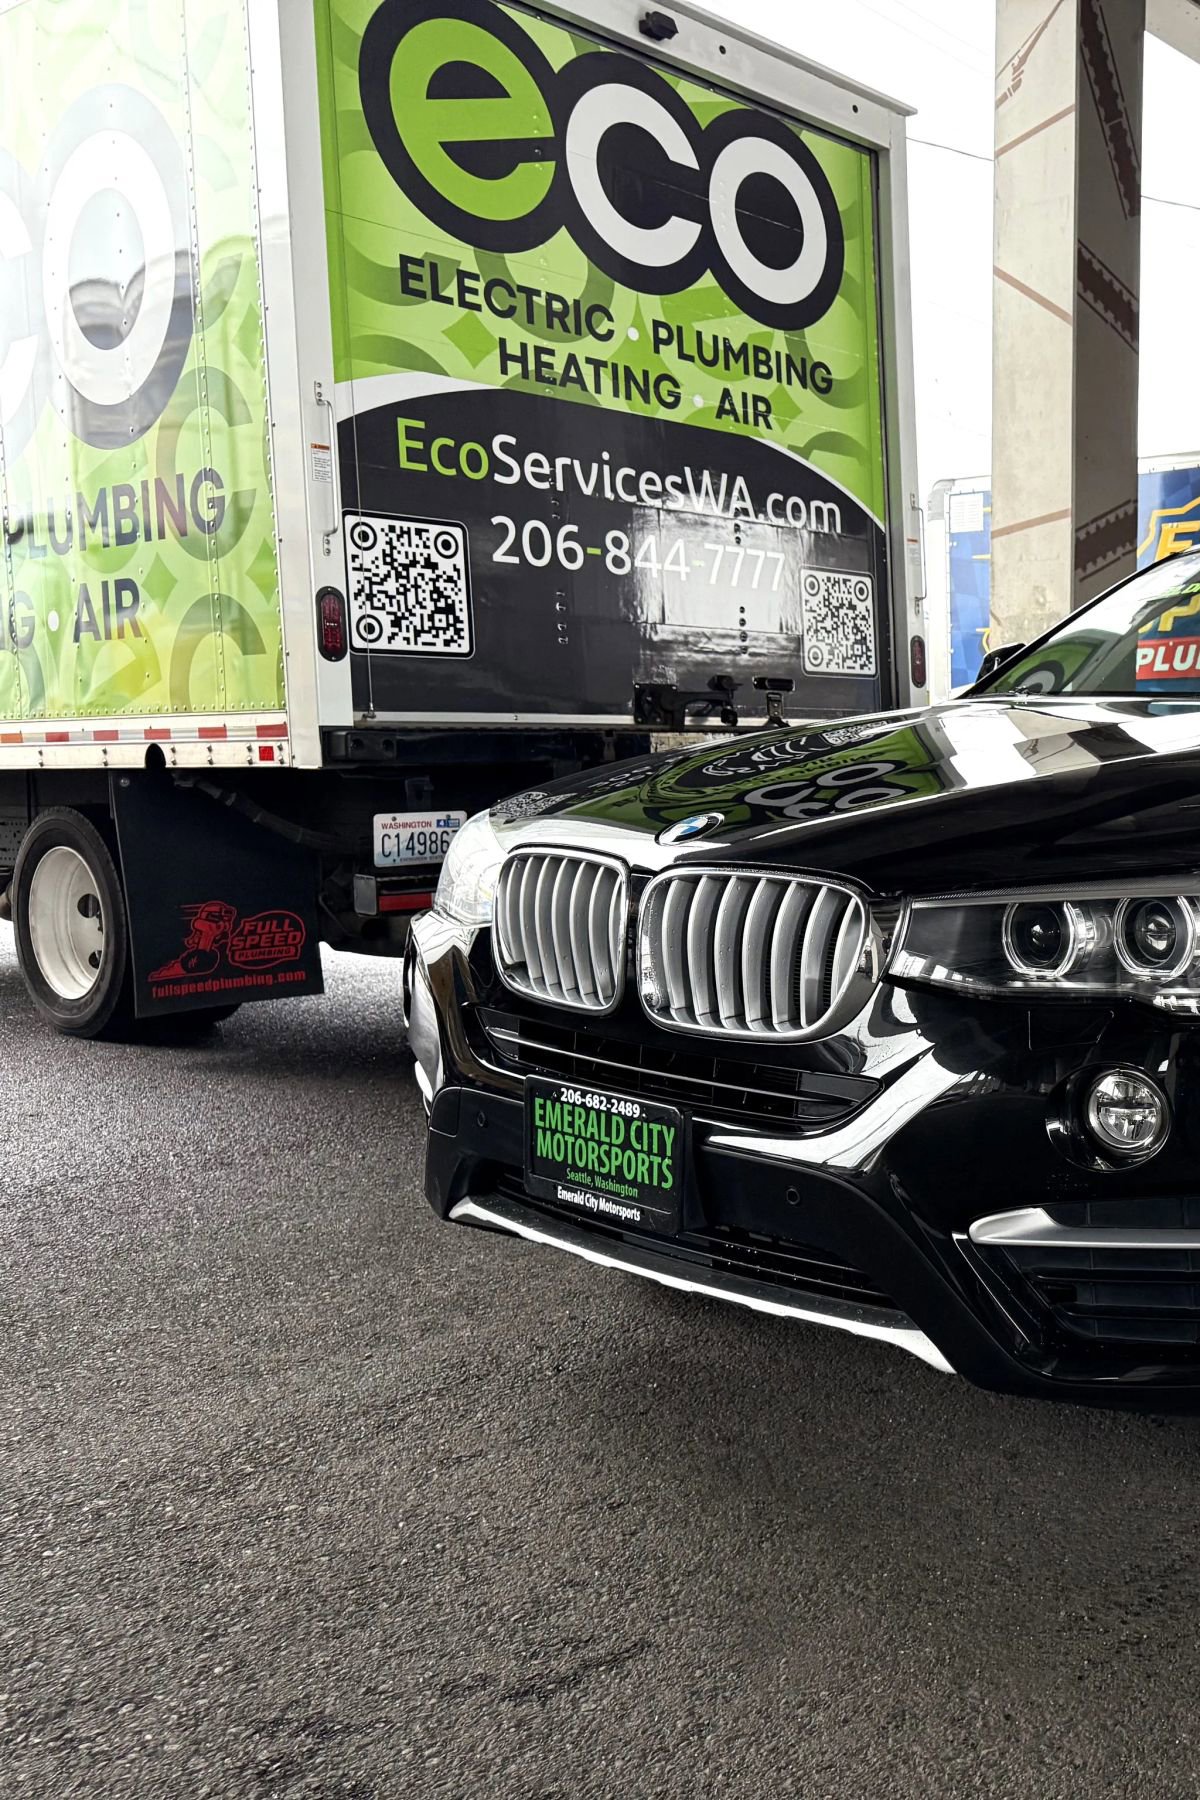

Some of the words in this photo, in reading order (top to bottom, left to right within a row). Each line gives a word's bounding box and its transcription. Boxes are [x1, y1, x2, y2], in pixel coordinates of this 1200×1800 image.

[389, 17, 828, 305] eco
[399, 254, 615, 341] ELECTRIC
[652, 320, 833, 395] PLUMBING
[500, 337, 682, 410] HEATING
[715, 388, 772, 430] AIR
[396, 417, 842, 533] EcoServicesWA.com
[491, 515, 786, 593] 206-844-7777
[73, 578, 143, 644] AIR
[381, 820, 433, 830] WASHINGTON
[231, 931, 302, 950] SPEED
[244, 919, 294, 936] FULL
[237, 947, 294, 961] PLUMBING
[152, 970, 306, 998] fullspeedplumbing.com
[534, 1097, 626, 1146] EMERALD
[630, 1120, 676, 1157] CITY
[560, 1087, 641, 1119] 206-682-2489
[536, 1129, 674, 1190] MOTORSPORTS
[566, 1167, 594, 1188] Seattle,
[594, 1174, 639, 1198] Washington
[557, 1185, 585, 1206] Emerald
[584, 1193, 599, 1213] City
[598, 1197, 641, 1222] Motorsports
